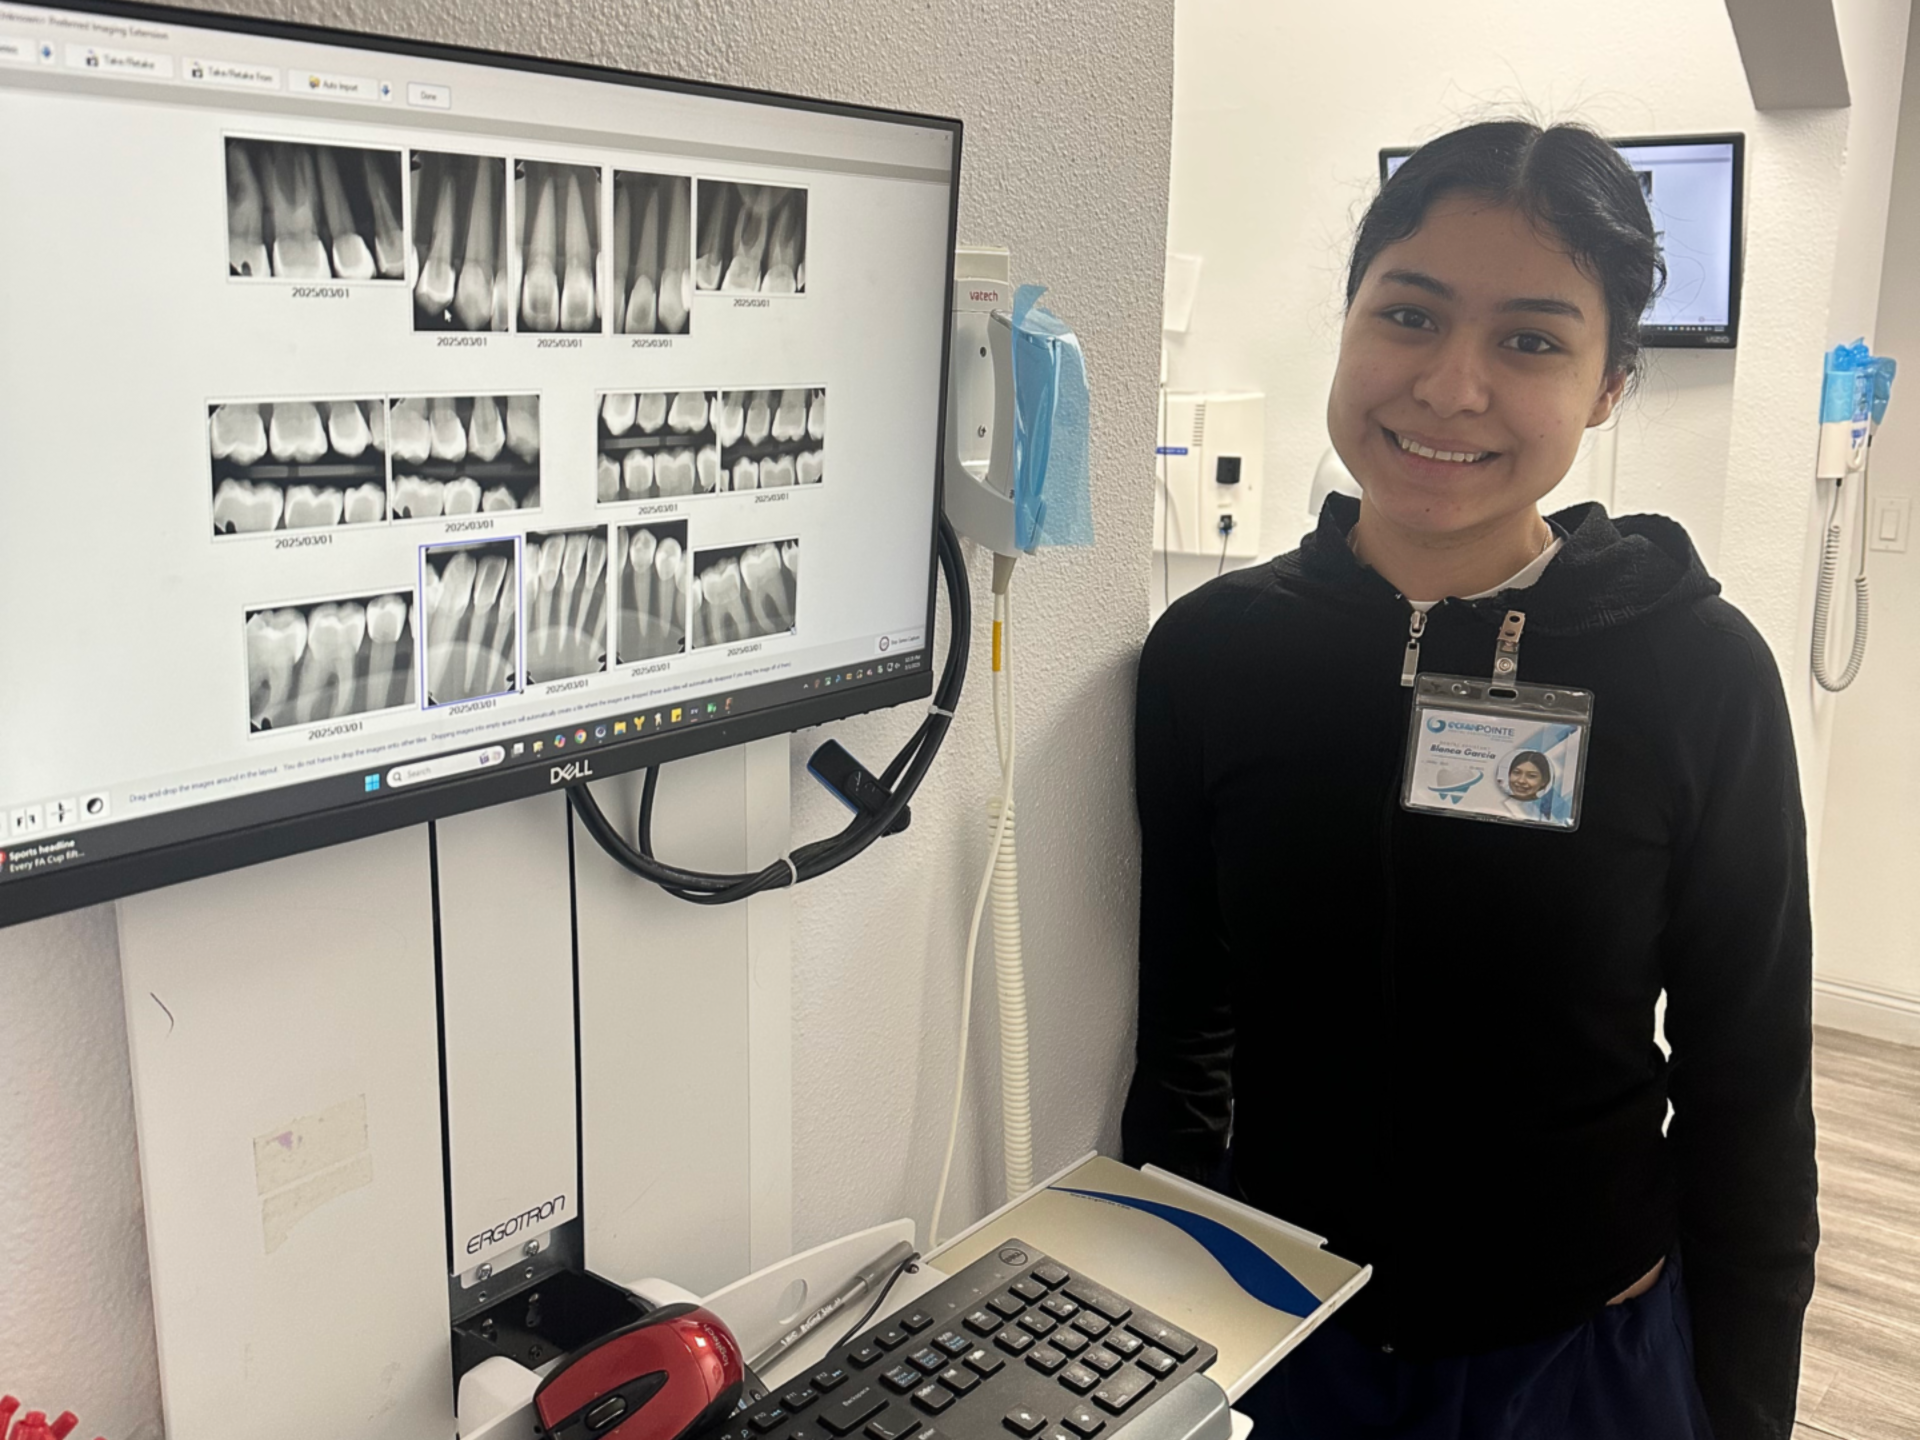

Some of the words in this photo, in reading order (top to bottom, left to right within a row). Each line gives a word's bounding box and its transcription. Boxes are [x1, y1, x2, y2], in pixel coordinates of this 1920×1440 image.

[322, 80, 338, 91] Auto
[420, 91, 437, 101] Done
[292, 287, 350, 298] 2025/03/01
[969, 290, 998, 302] vatech
[733, 299, 770, 308] 2025/03/01
[437, 337, 488, 347] 2025/03/01
[537, 338, 583, 348] 2025/03/01
[632, 338, 673, 348] 2025/03/01
[755, 493, 790, 504] 2025/03/01
[638, 504, 678, 515] 2025/03/01
[444, 519, 494, 533] 2025/03/01
[275, 534, 332, 549] 2025/03/01
[727, 643, 762, 657] 2025/03/01
[631, 662, 670, 677] 2025/03/01
[546, 678, 588, 695] 2025/03/01
[449, 699, 496, 716] 2025/03/01
[308, 721, 363, 740] 2025/03/01
[179, 784, 190, 792] the
[247, 770, 258, 779] the
[356, 748, 364, 756] the
[407, 766, 432, 779] Search
[550, 760, 592, 784] DELL
[9, 848, 38, 862] Sports
[38, 840, 76, 854] headline
[10, 861, 34, 873] Every
[35, 858, 46, 866] FA
[47, 854, 65, 864] Cup
[466, 1194, 566, 1254] ERGOTRON
[704, 1323, 728, 1366] logitech
[786, 1392, 797, 1400] F11
[842, 1386, 870, 1407] Backspace
